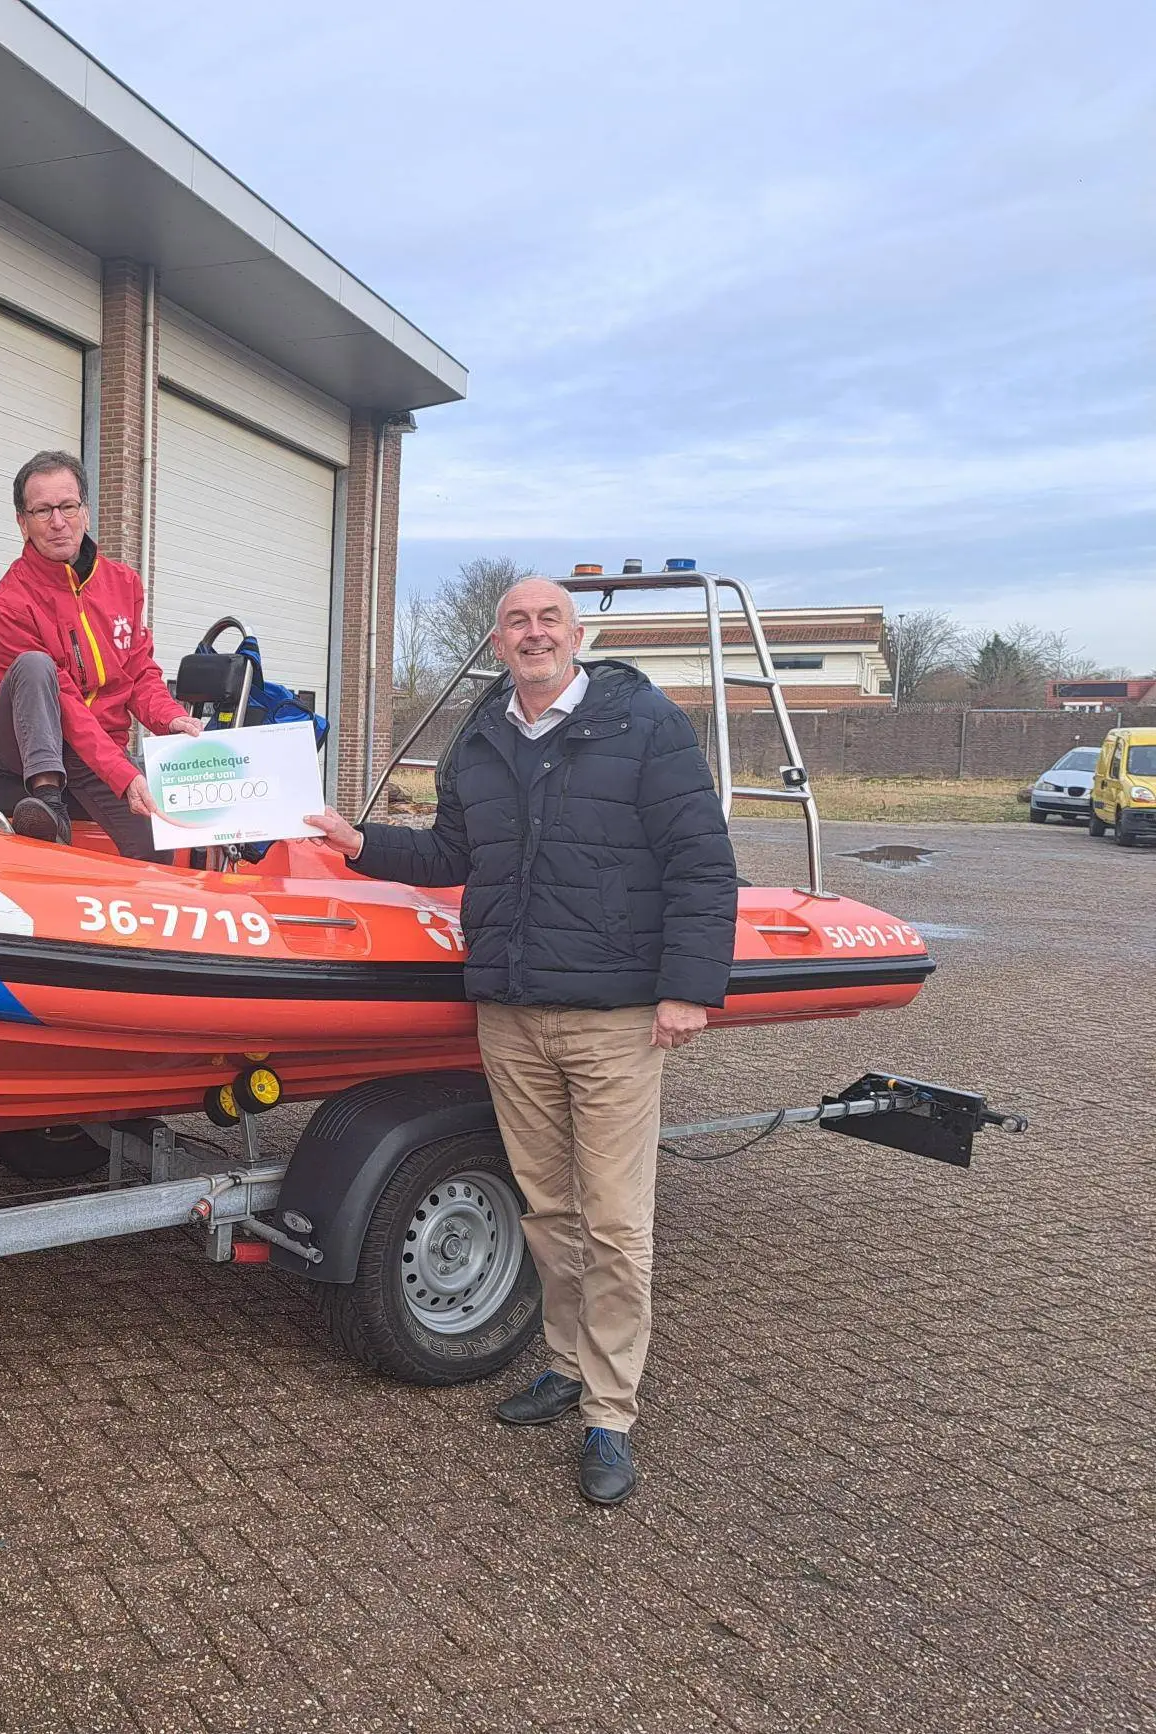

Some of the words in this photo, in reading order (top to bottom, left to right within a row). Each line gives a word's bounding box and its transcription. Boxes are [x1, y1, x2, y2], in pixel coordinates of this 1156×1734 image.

[159, 756, 251, 772] Waardecheque
[177, 772, 215, 782] waarde
[216, 770, 236, 779] van
[168, 794, 178, 805] €
[75, 895, 271, 946] 36-7719
